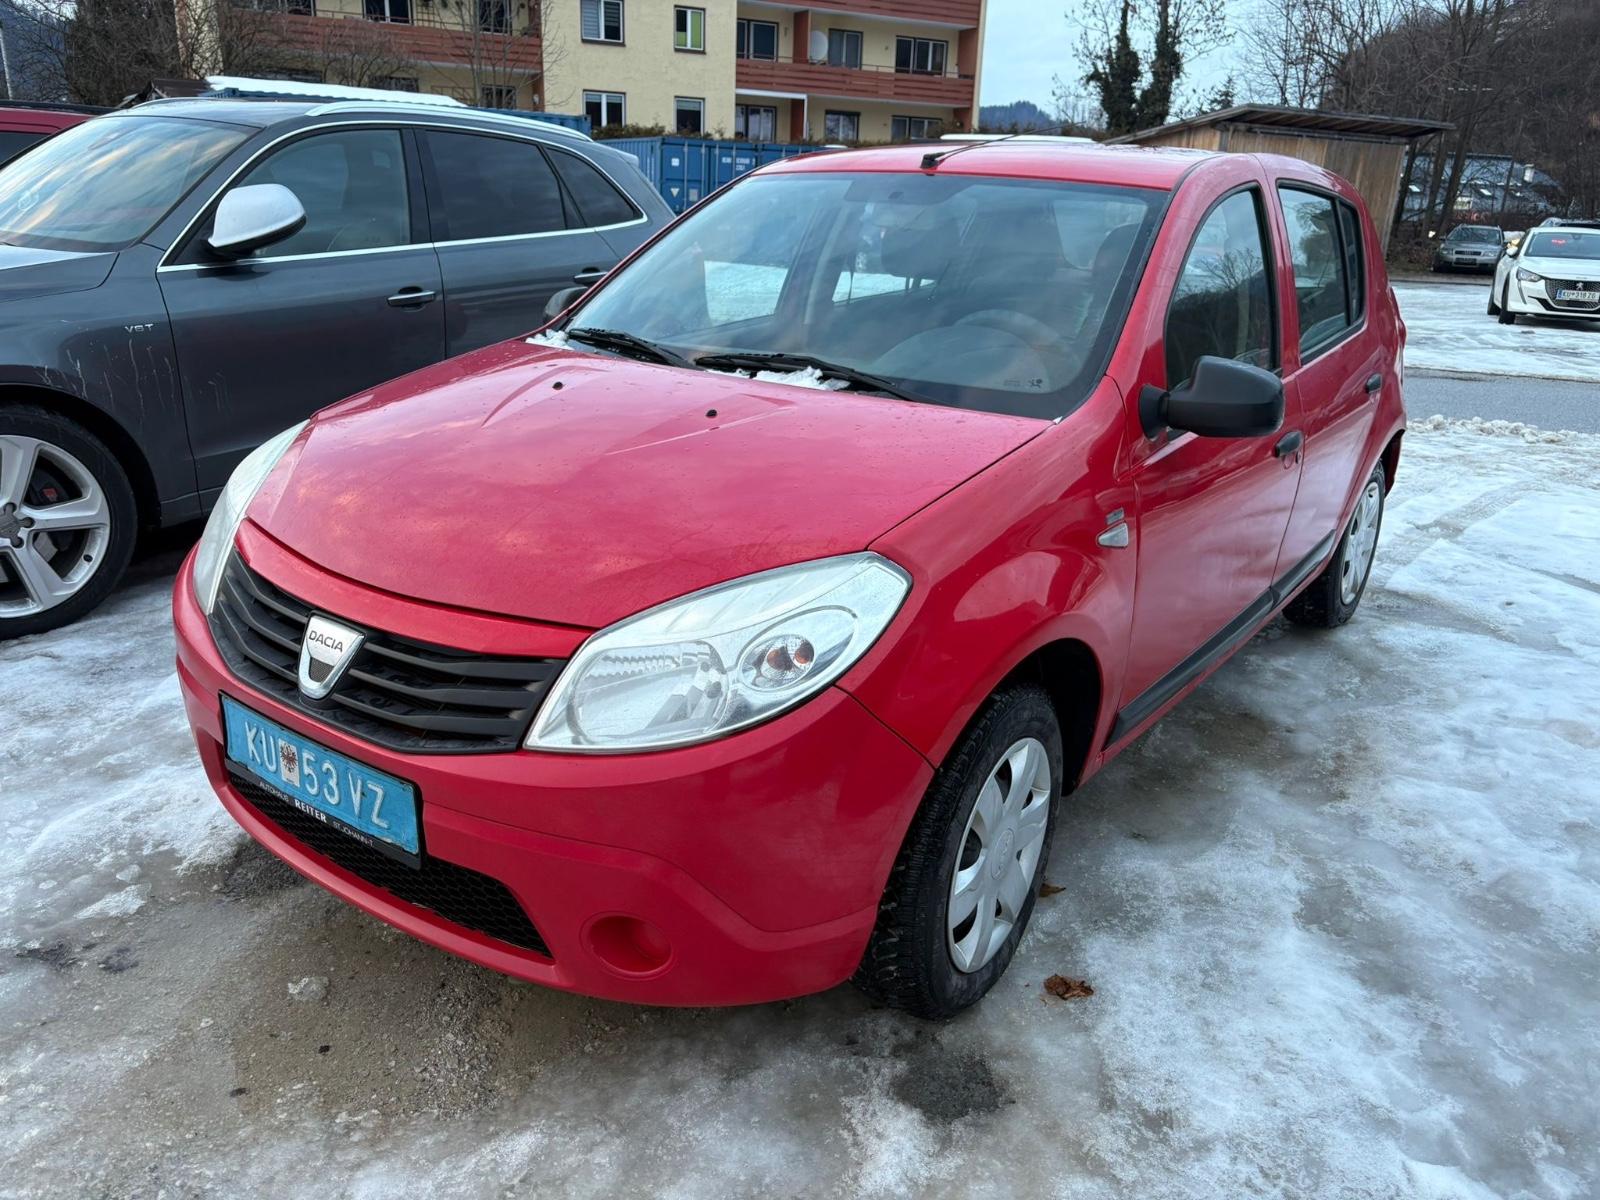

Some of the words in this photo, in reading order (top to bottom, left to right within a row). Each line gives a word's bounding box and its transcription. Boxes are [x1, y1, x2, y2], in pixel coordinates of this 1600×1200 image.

[124, 323, 154, 333] V6T
[308, 630, 343, 653] DACIA
[244, 721, 278, 773] KU
[302, 751, 340, 805] 53
[348, 771, 389, 828] VZ
[294, 799, 327, 823] REITER
